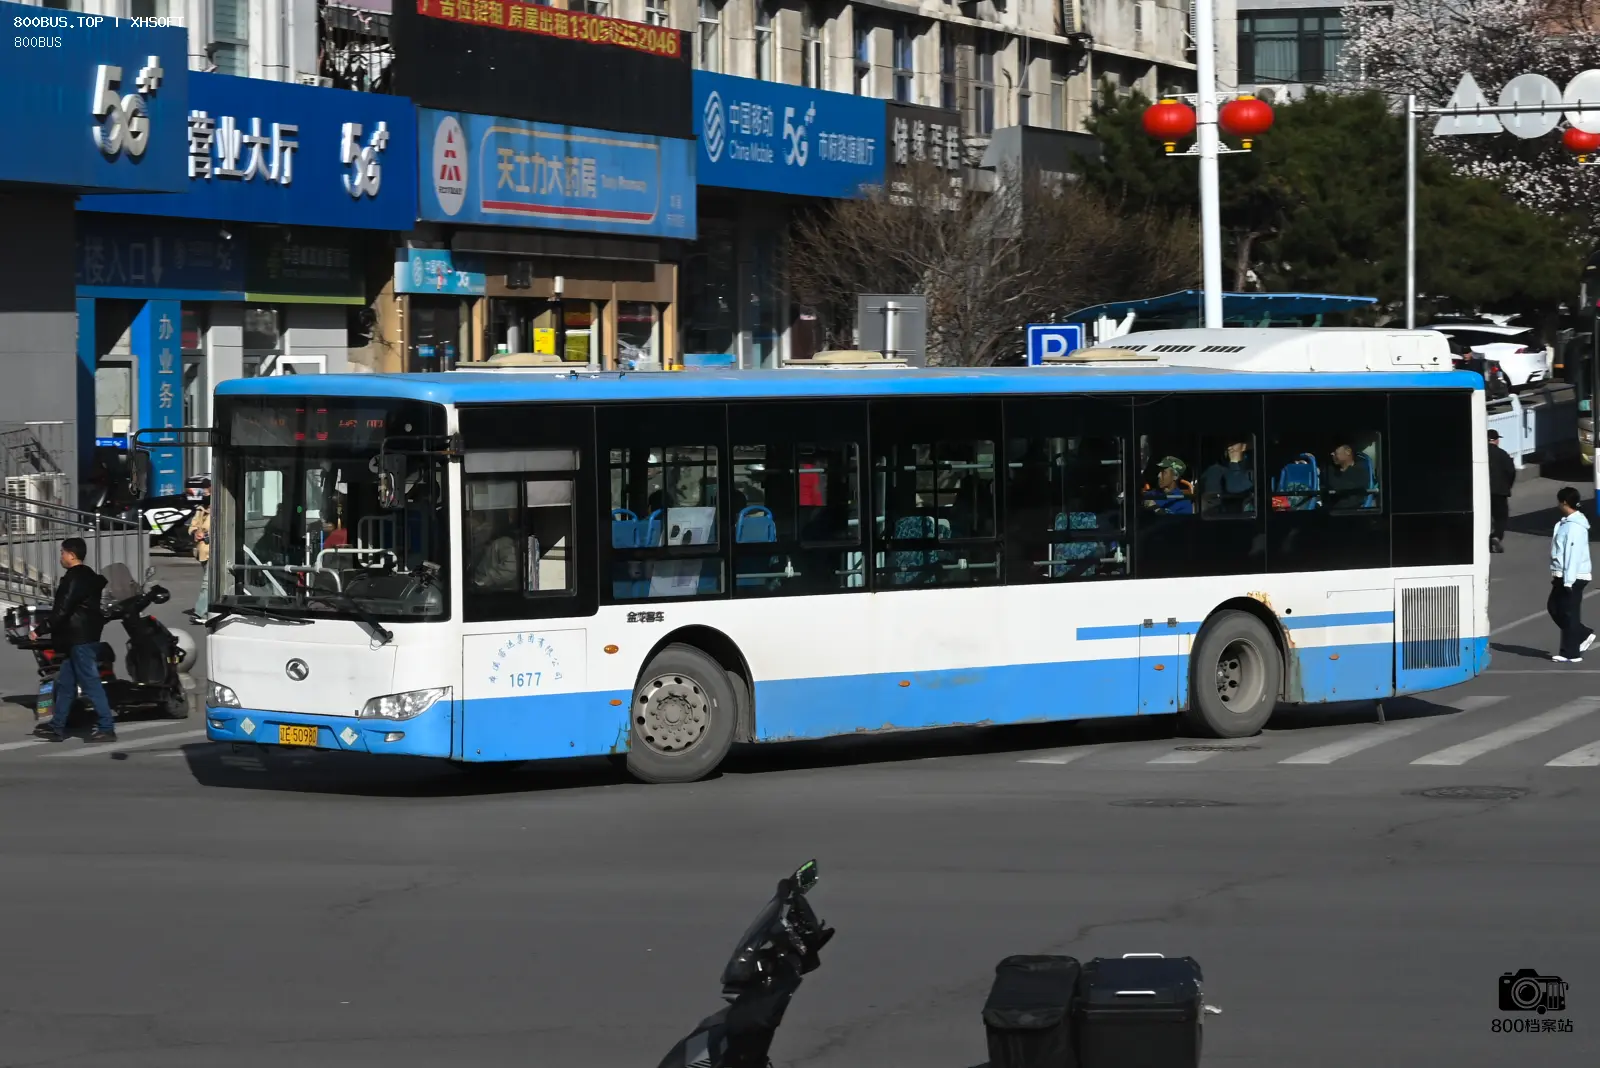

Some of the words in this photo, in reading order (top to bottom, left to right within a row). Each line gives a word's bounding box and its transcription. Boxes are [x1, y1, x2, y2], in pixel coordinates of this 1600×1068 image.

[729, 100, 774, 138] 中国移动
[188, 110, 299, 186] 营业大厅
[729, 140, 750, 161] China
[750, 142, 774, 163] Mobile
[510, 671, 542, 688] 1677
